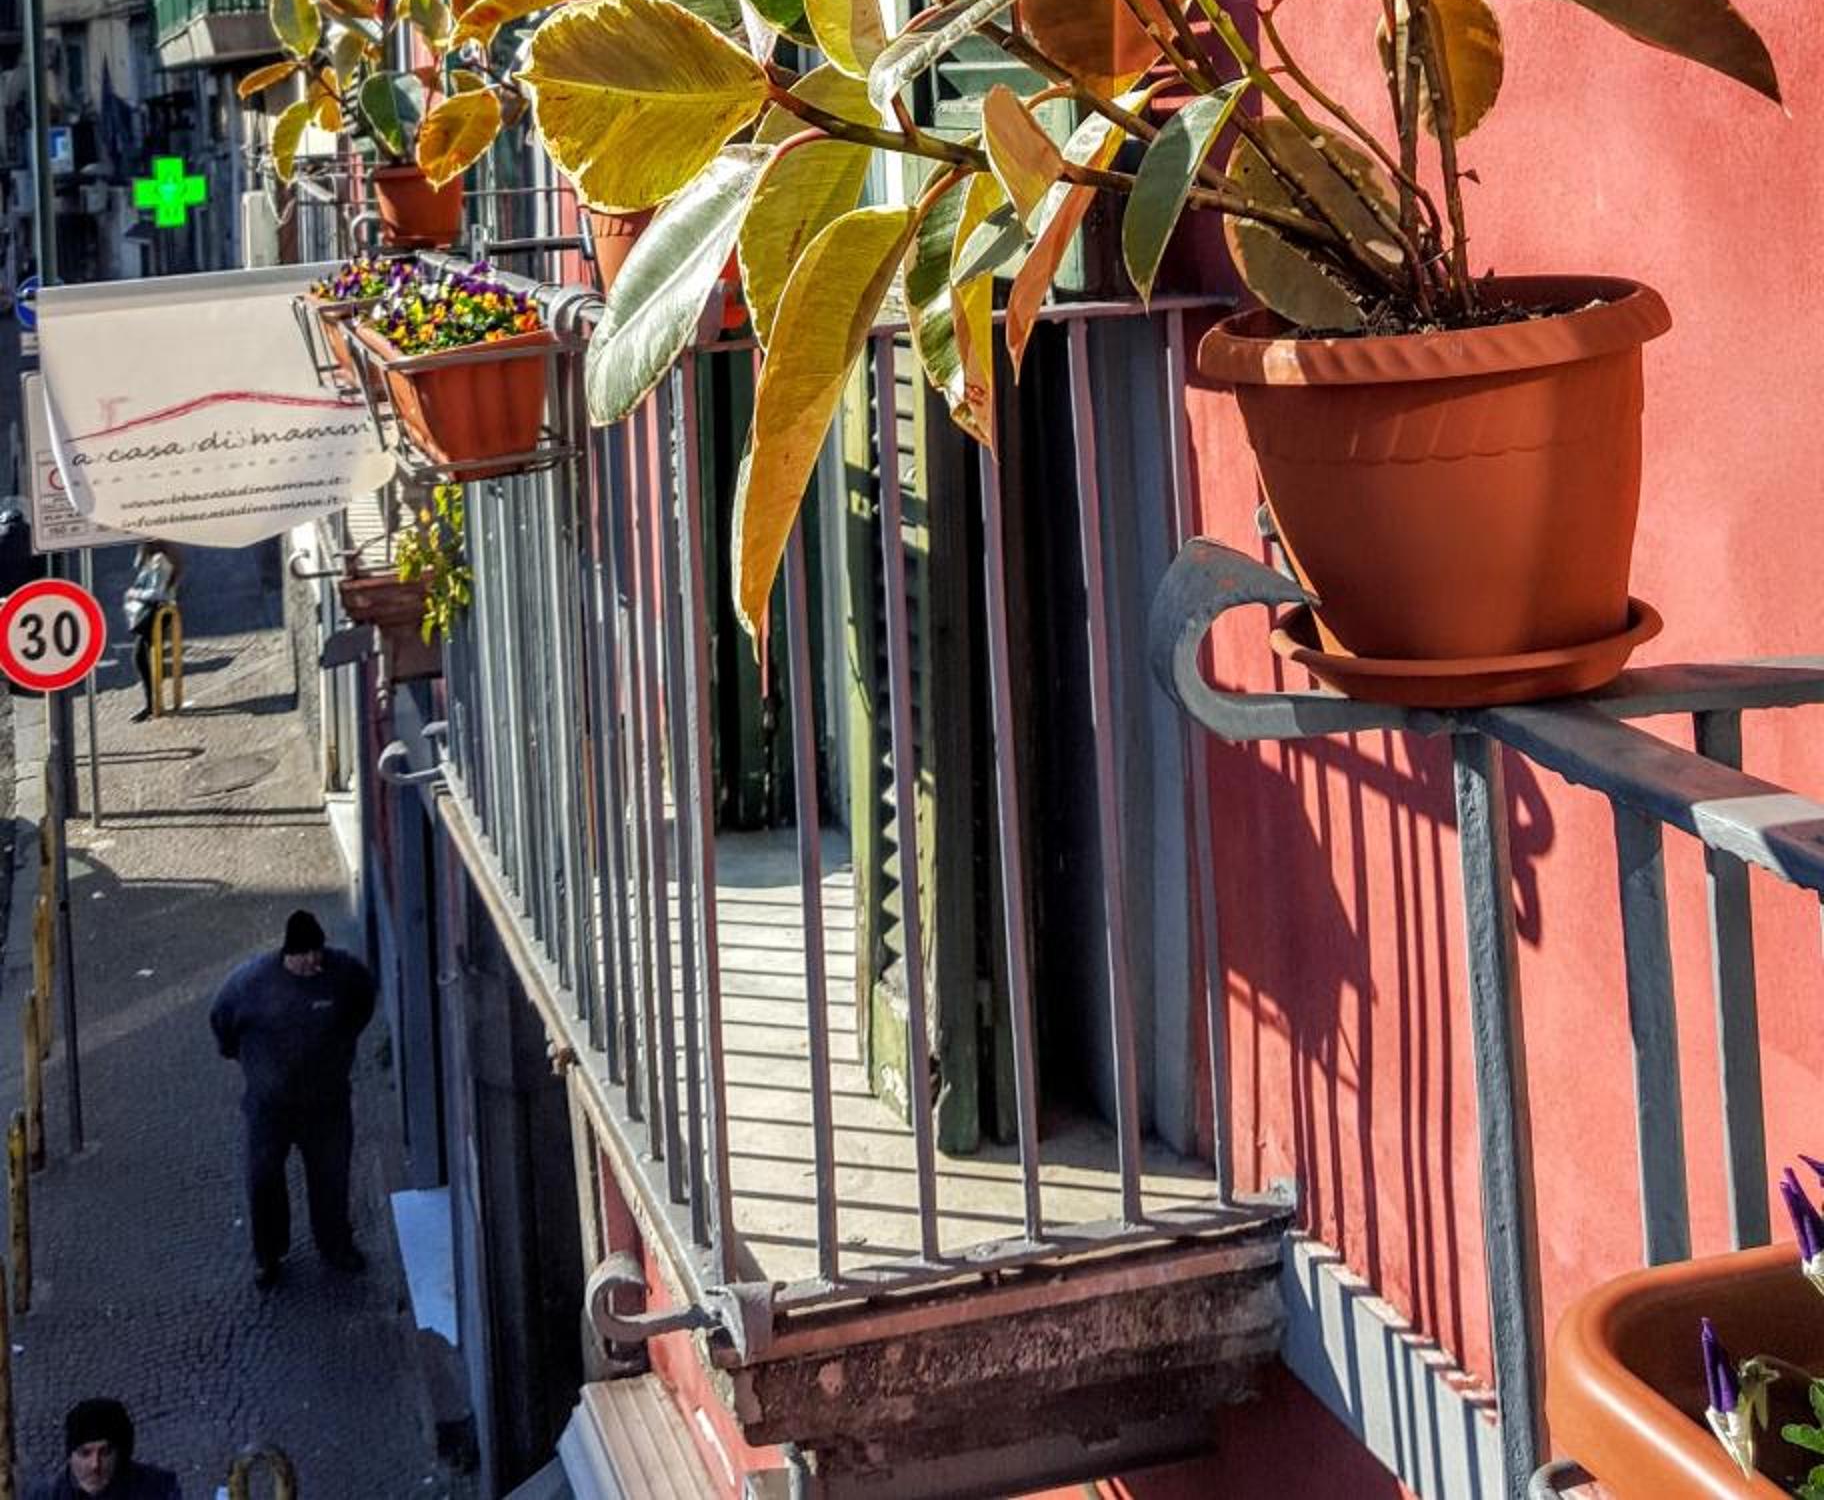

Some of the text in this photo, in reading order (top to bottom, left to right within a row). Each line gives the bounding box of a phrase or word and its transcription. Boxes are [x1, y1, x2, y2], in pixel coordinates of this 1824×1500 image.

[107, 441, 185, 463] casa
[198, 430, 238, 451] di
[251, 421, 371, 445] mamm
[19, 610, 80, 661] 30
